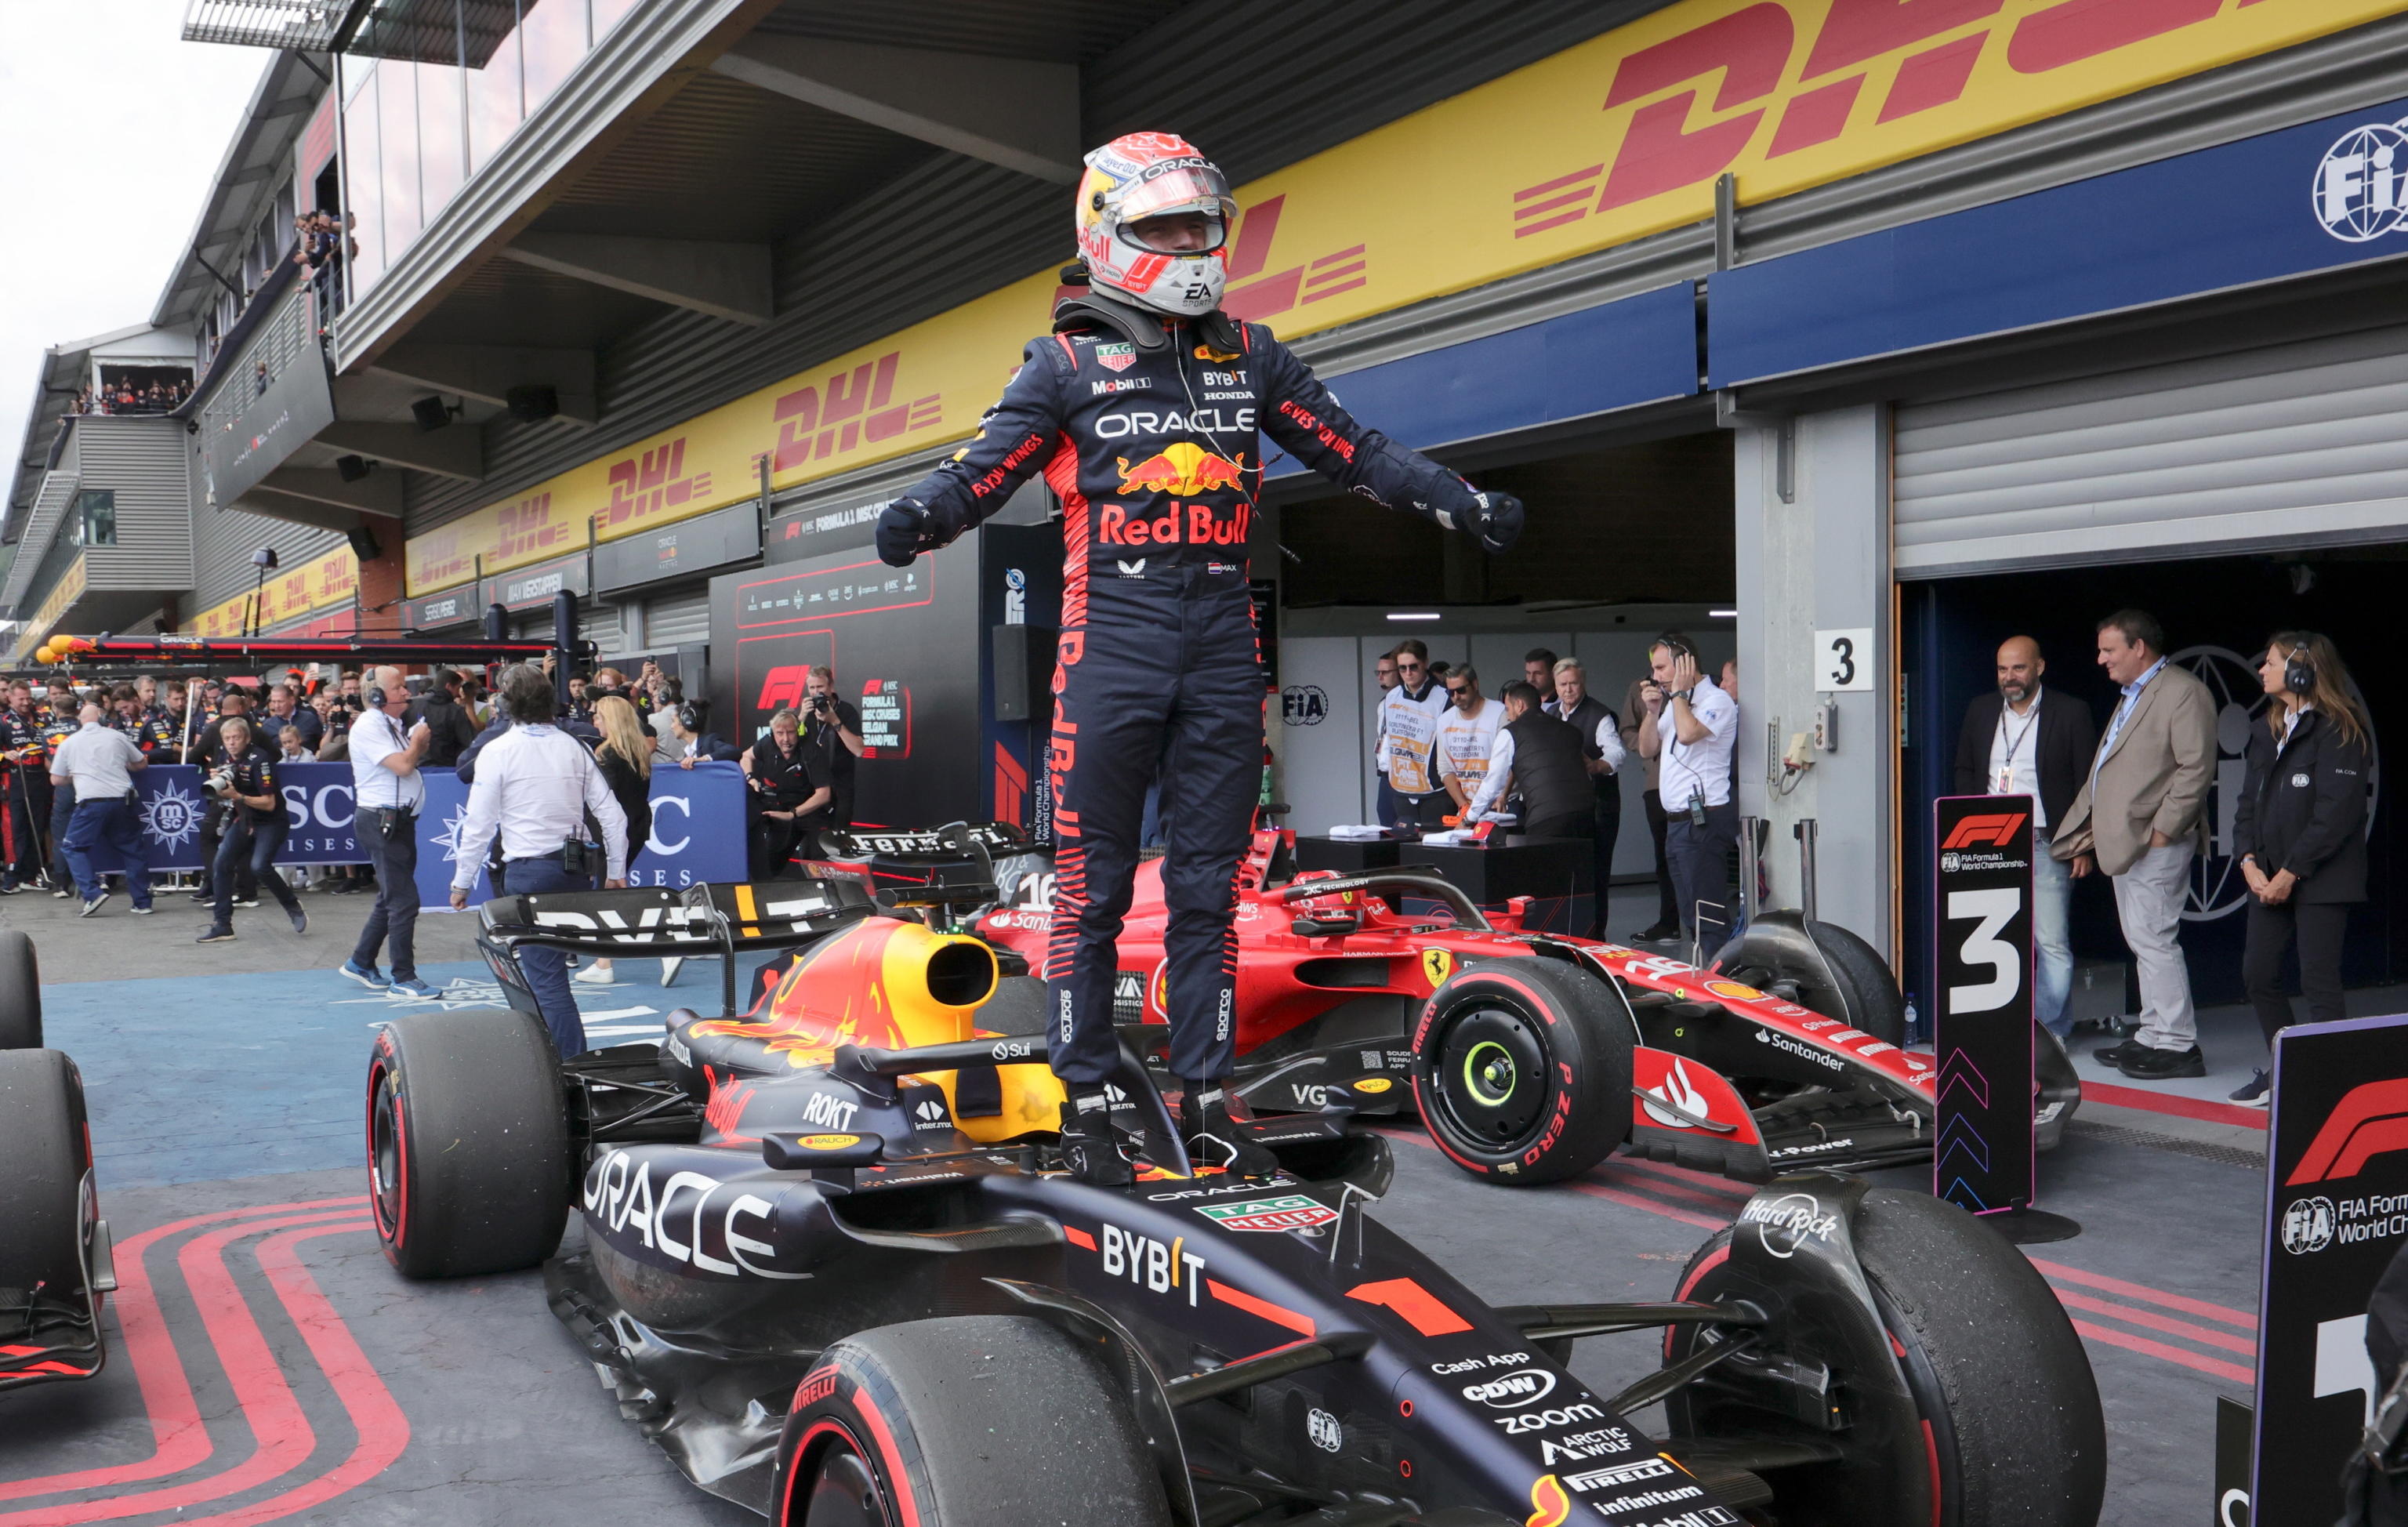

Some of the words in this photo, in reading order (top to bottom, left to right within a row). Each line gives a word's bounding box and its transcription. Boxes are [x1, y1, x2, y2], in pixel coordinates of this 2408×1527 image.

[1184, 282, 1212, 299] EA
[1099, 344, 1134, 354] TAG
[1099, 354, 1137, 371] HEUER
[1092, 379, 1135, 395] Mobil
[1202, 370, 1247, 387] BYBIT
[1204, 391, 1256, 401] HONDA
[771, 350, 912, 473] DHL
[1095, 408, 1256, 439] ORACLE
[1003, 433, 1046, 471] WINGS
[607, 437, 694, 524] DHL
[496, 493, 557, 560] DHL
[816, 510, 850, 533] FORMULA
[1099, 502, 1180, 545] Red
[1188, 503, 1249, 544] Bull
[1220, 564, 1237, 572] MAX
[1830, 637, 1855, 686] 3
[862, 695, 890, 708] FORMULA
[1282, 694, 1325, 718] FIA
[876, 708, 901, 720] CRUISES
[862, 721, 888, 733] BELGIAN
[863, 734, 883, 746] GRAND
[883, 734, 898, 746] PRIX
[1043, 745, 1051, 815] Championship
[2292, 775, 2310, 785] FIA
[1942, 855, 1960, 869] FIA
[1962, 861, 1981, 870] World
[1973, 853, 2000, 861] Formula
[1019, 872, 1057, 912] 16
[1322, 878, 1370, 891] TECHNOLOGY
[1948, 887, 2021, 1015] 3
[1625, 956, 1701, 981] 16
[1216, 988, 1232, 1041] sparco
[1412, 1000, 1439, 1054] PIRELLI
[668, 1032, 693, 1069] HONDA
[1009, 1042, 1031, 1057] Sui
[1772, 1032, 1845, 1073] Santander
[1558, 1061, 1573, 1085] P
[1291, 1083, 1327, 1106] VG
[803, 1091, 858, 1132] ROKT
[915, 1121, 952, 1131] inter.mx
[814, 1135, 852, 1144] RAUCH
[885, 1172, 964, 1186] Walmart
[1147, 1178, 1298, 1202] ORACLE
[584, 1148, 815, 1279] ORACLE
[1219, 1196, 1306, 1216] TAG
[2338, 1198, 2367, 1221] FIA
[1221, 1210, 1336, 1229] HEUER
[1743, 1199, 1787, 1229] Hard
[1786, 1210, 1839, 1241] Rock
[2285, 1208, 2330, 1246] FIA
[2338, 1217, 2388, 1245] World
[1103, 1224, 1206, 1308] BYBIT
[1345, 1278, 1474, 1337] 1
[1431, 1358, 1485, 1375] Cash
[1489, 1351, 1530, 1366] App
[792, 1362, 842, 1414] PIRELLI
[1463, 1376, 1536, 1402] CDW
[1494, 1403, 1605, 1435] zoom
[1310, 1417, 1341, 1450] FIA
[1561, 1427, 1628, 1448] ARCTIC
[1579, 1438, 1633, 1457] WOLF
[1561, 1457, 1674, 1492] PIRELLI
[1593, 1485, 1705, 1516] infinitum
